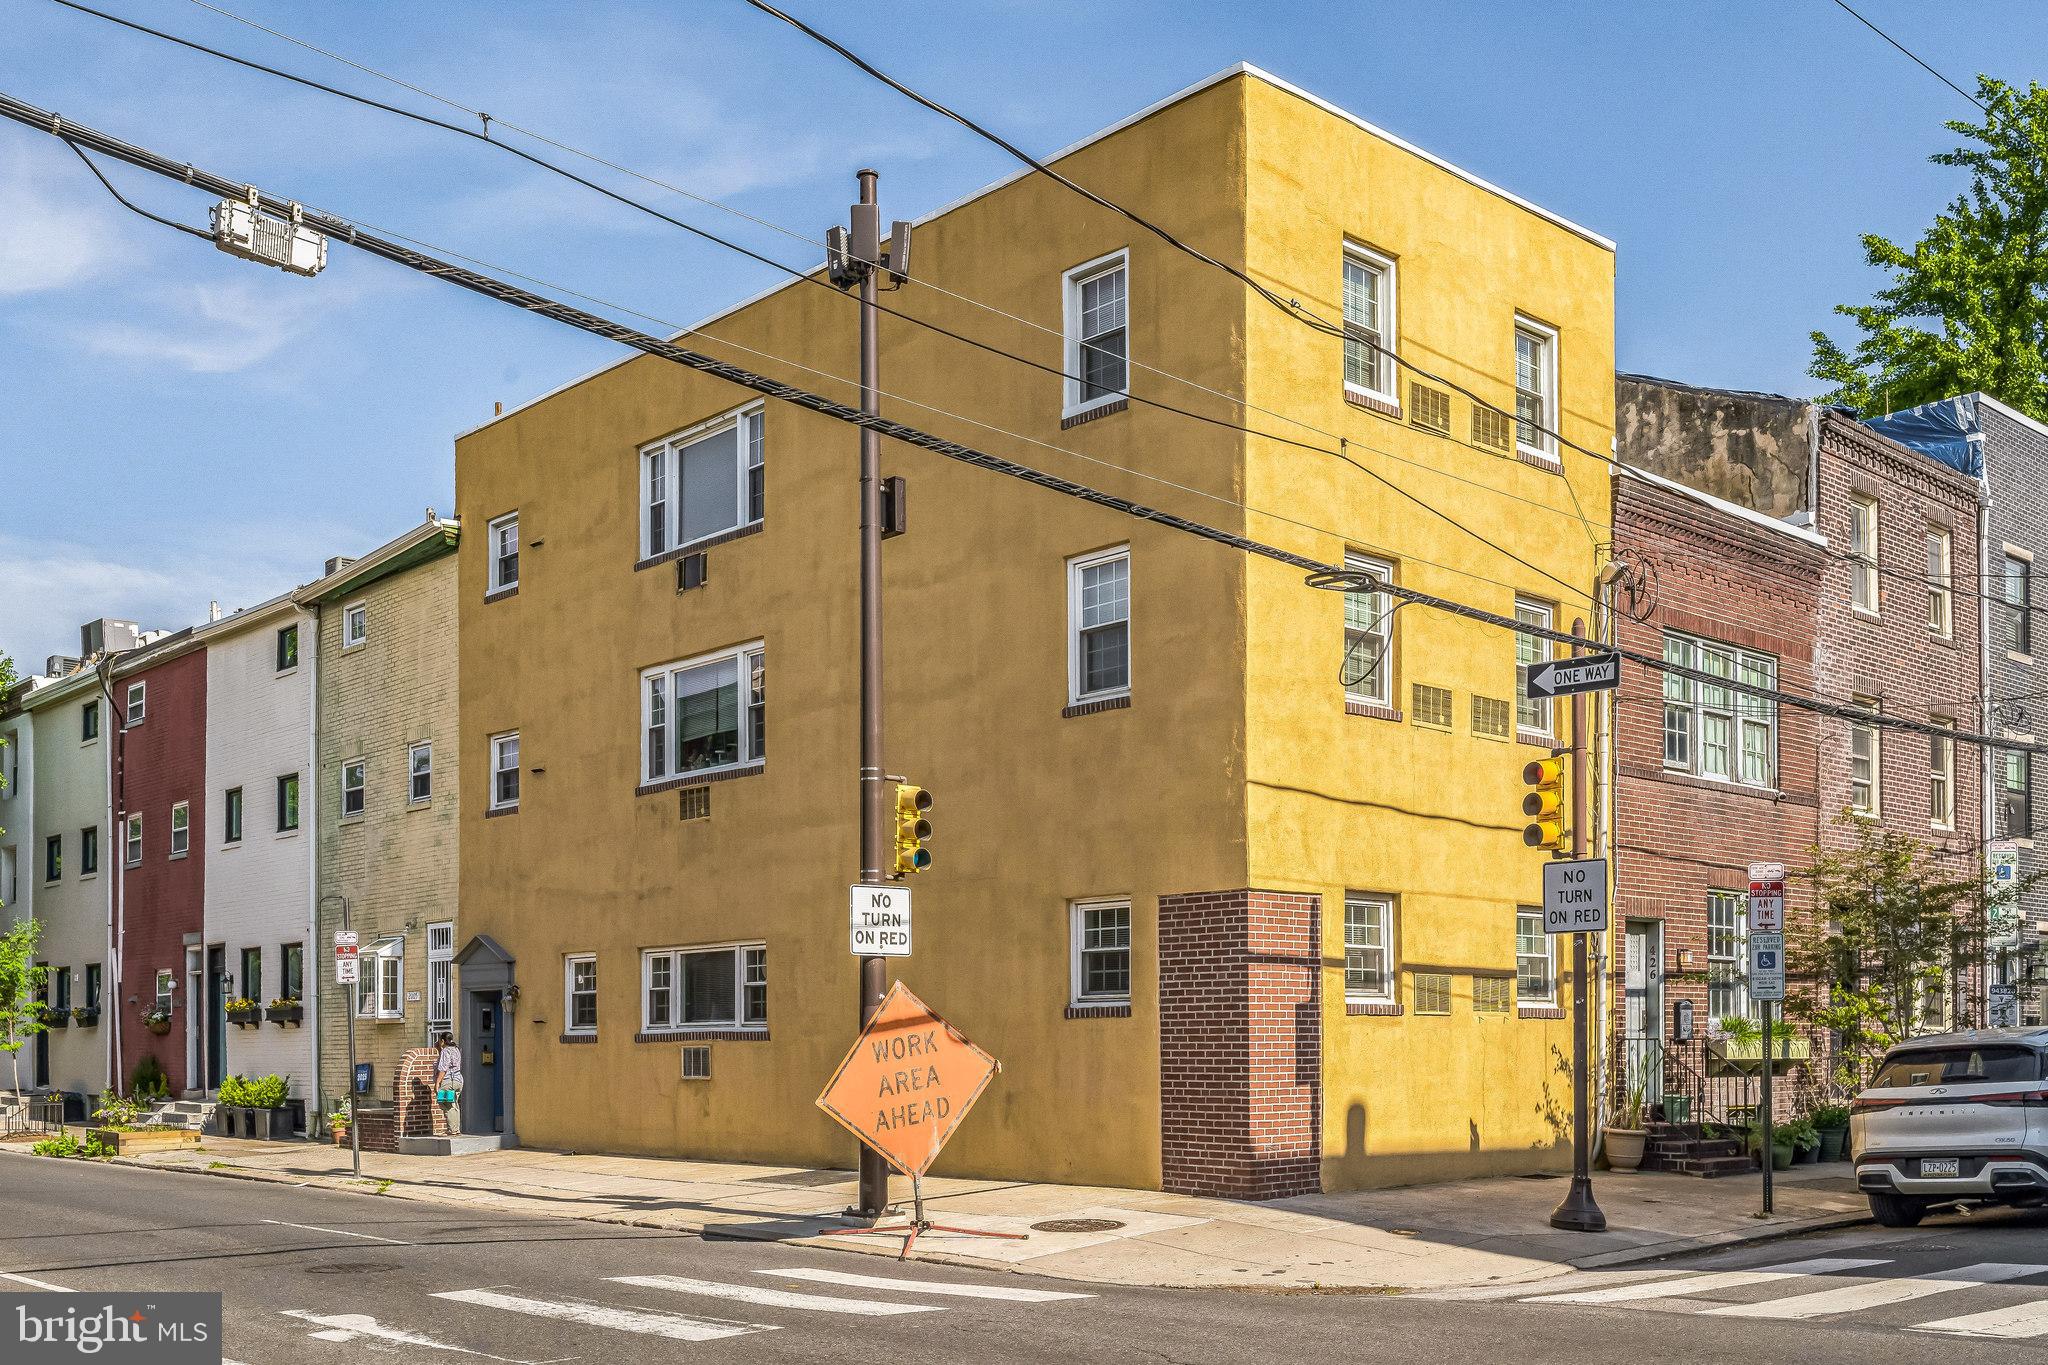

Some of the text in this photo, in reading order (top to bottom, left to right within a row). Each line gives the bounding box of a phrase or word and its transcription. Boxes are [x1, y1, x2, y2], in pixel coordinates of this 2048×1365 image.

[1554, 665, 1610, 685] ONE WAY
[1563, 870, 1586, 884] NO
[1558, 889, 1592, 903] TURN
[1751, 889, 1782, 897] STOPPING
[871, 894, 891, 908] NO
[1757, 899, 1774, 908] ANY
[862, 912, 901, 927] TURN
[1549, 909, 1601, 924] ON RED
[1757, 910, 1775, 919] TIME
[855, 930, 908, 945] ON RED
[1649, 946, 1657, 980] 426
[872, 1030, 938, 1064] WORK
[878, 1065, 941, 1098] AREA
[875, 1096, 950, 1133] AHEAD
[1900, 1108, 1976, 1116] INFINITI
